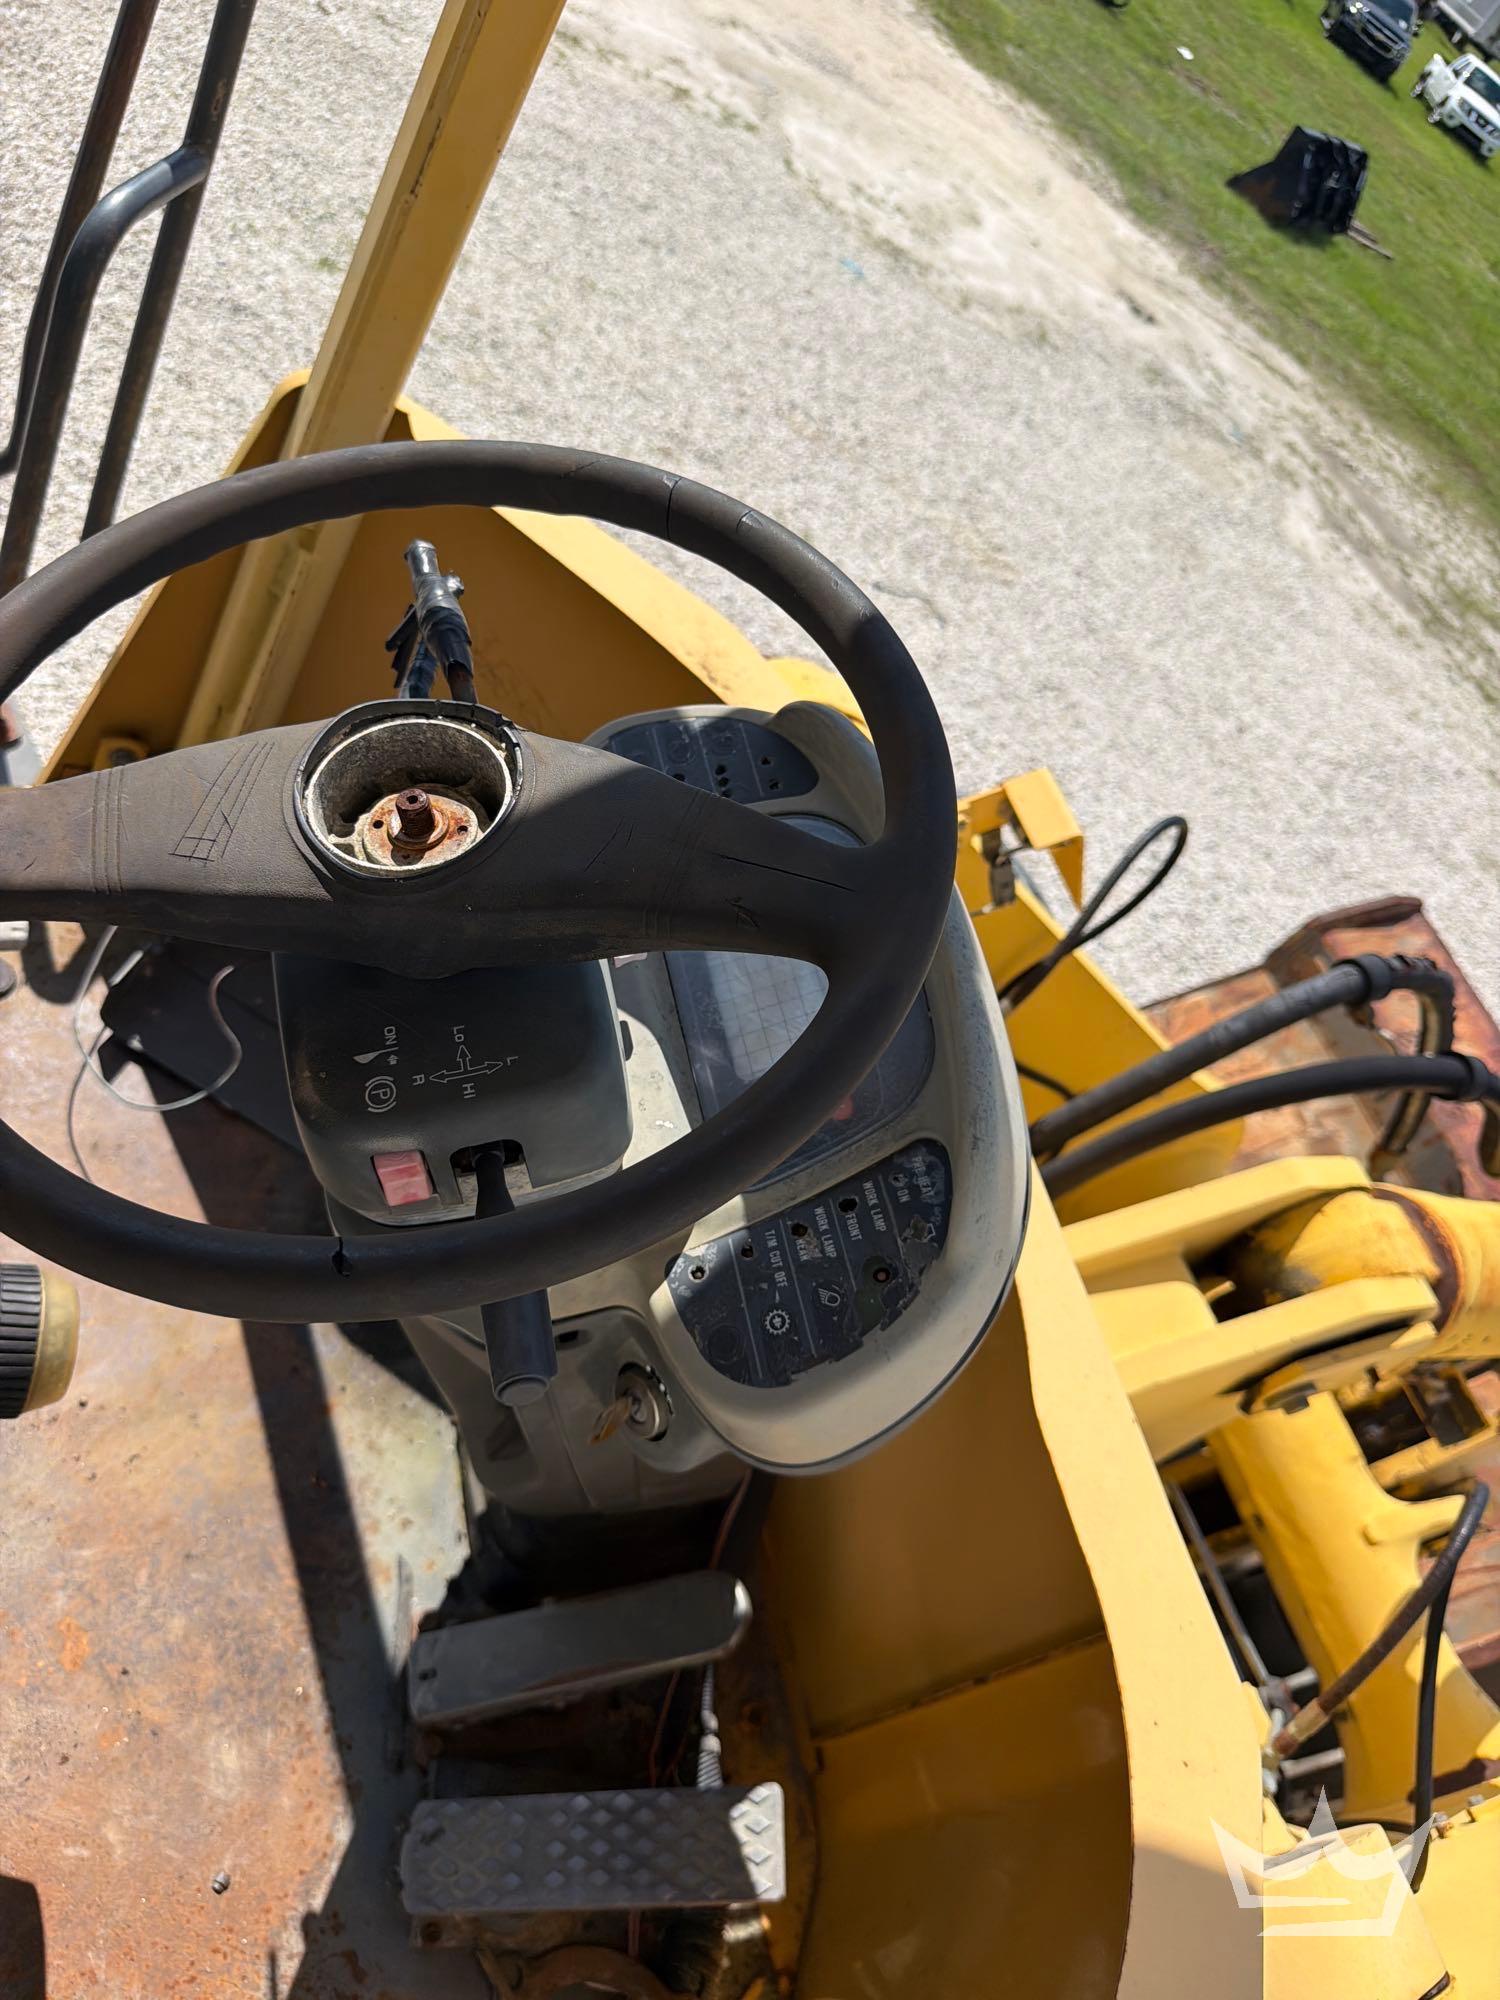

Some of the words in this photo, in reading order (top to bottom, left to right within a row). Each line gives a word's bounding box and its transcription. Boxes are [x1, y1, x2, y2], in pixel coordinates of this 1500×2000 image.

[384, 1026, 397, 1045] ON
[506, 1056, 519, 1066] L
[412, 1074, 425, 1086] R
[462, 1082, 476, 1099] HI
[896, 1189, 911, 1203] ON
[862, 1180, 878, 1207] WORK
[871, 1209, 887, 1232] LAMP
[814, 1206, 830, 1232] WORK
[845, 1213, 863, 1241] FRONT
[764, 1229, 777, 1248] T/M
[821, 1234, 837, 1259] LAMP
[769, 1250, 782, 1268] CUT
[774, 1271, 788, 1288] OFF
